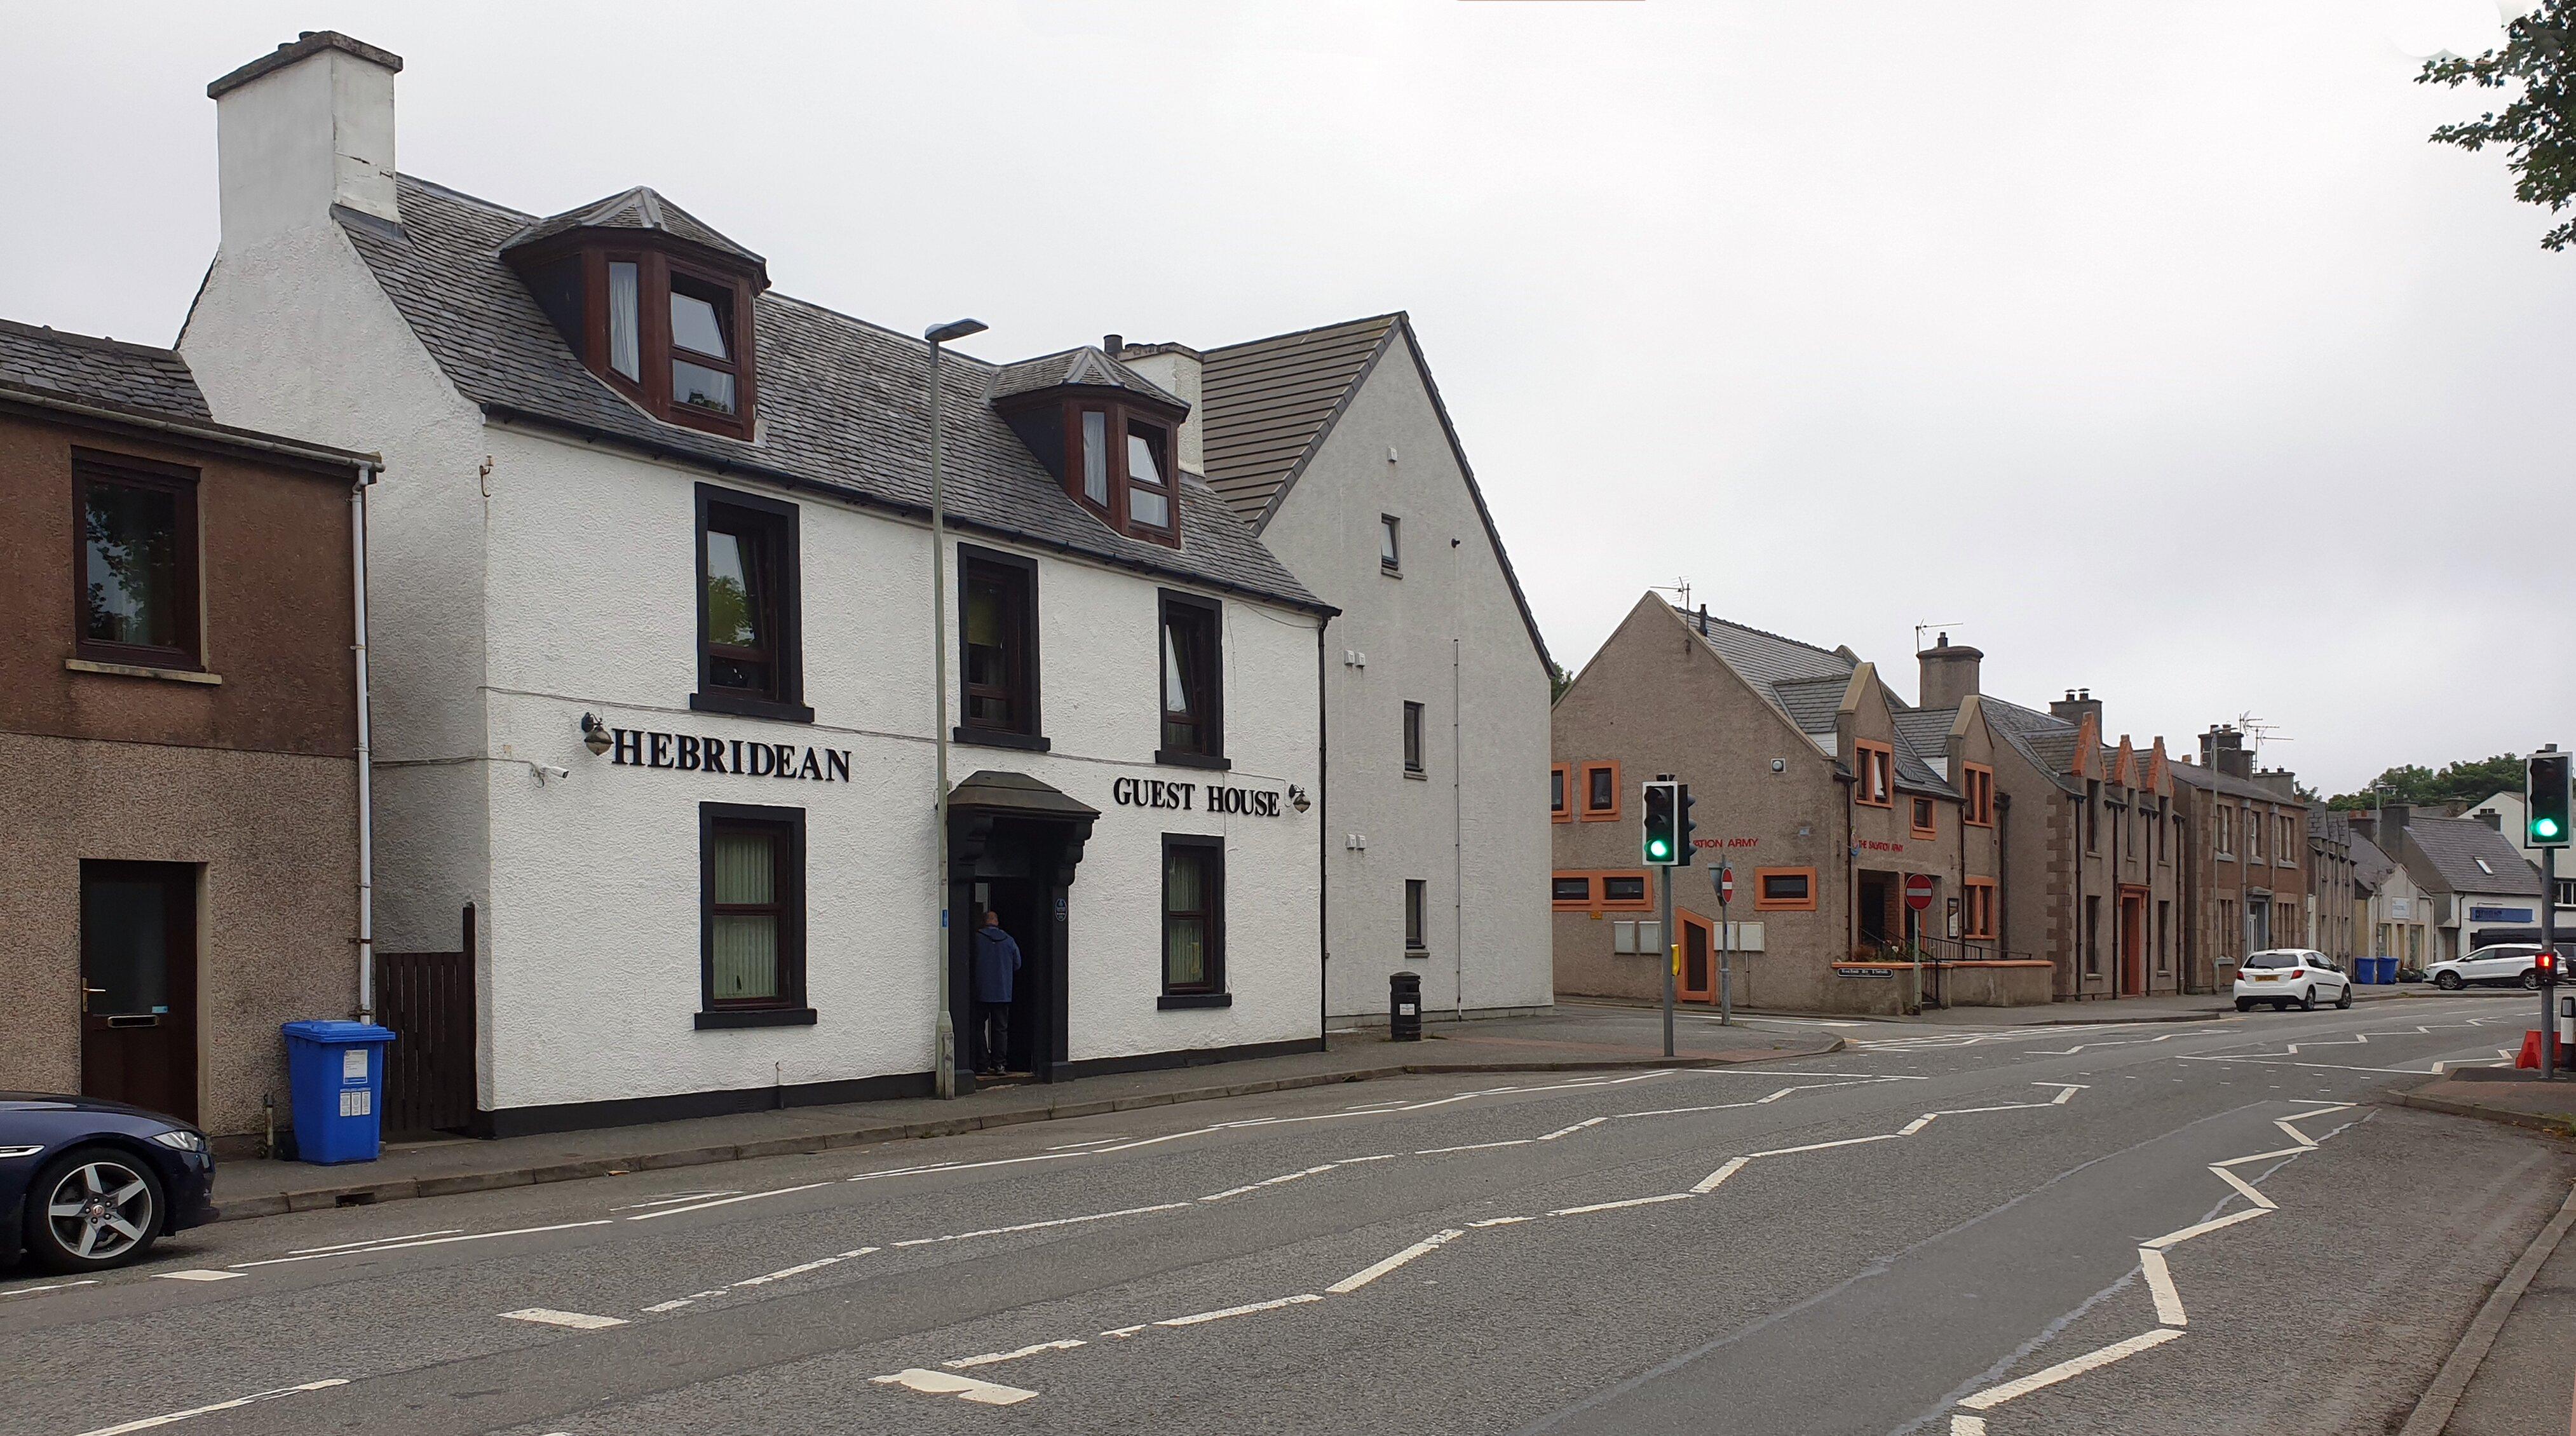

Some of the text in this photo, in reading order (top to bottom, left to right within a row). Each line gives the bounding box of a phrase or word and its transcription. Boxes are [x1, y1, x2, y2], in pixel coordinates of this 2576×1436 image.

[611, 728, 852, 783] HEBRIDEAN
[1113, 776, 1280, 817] GUEST HOUSE
[1728, 838, 1758, 848] ARMY
